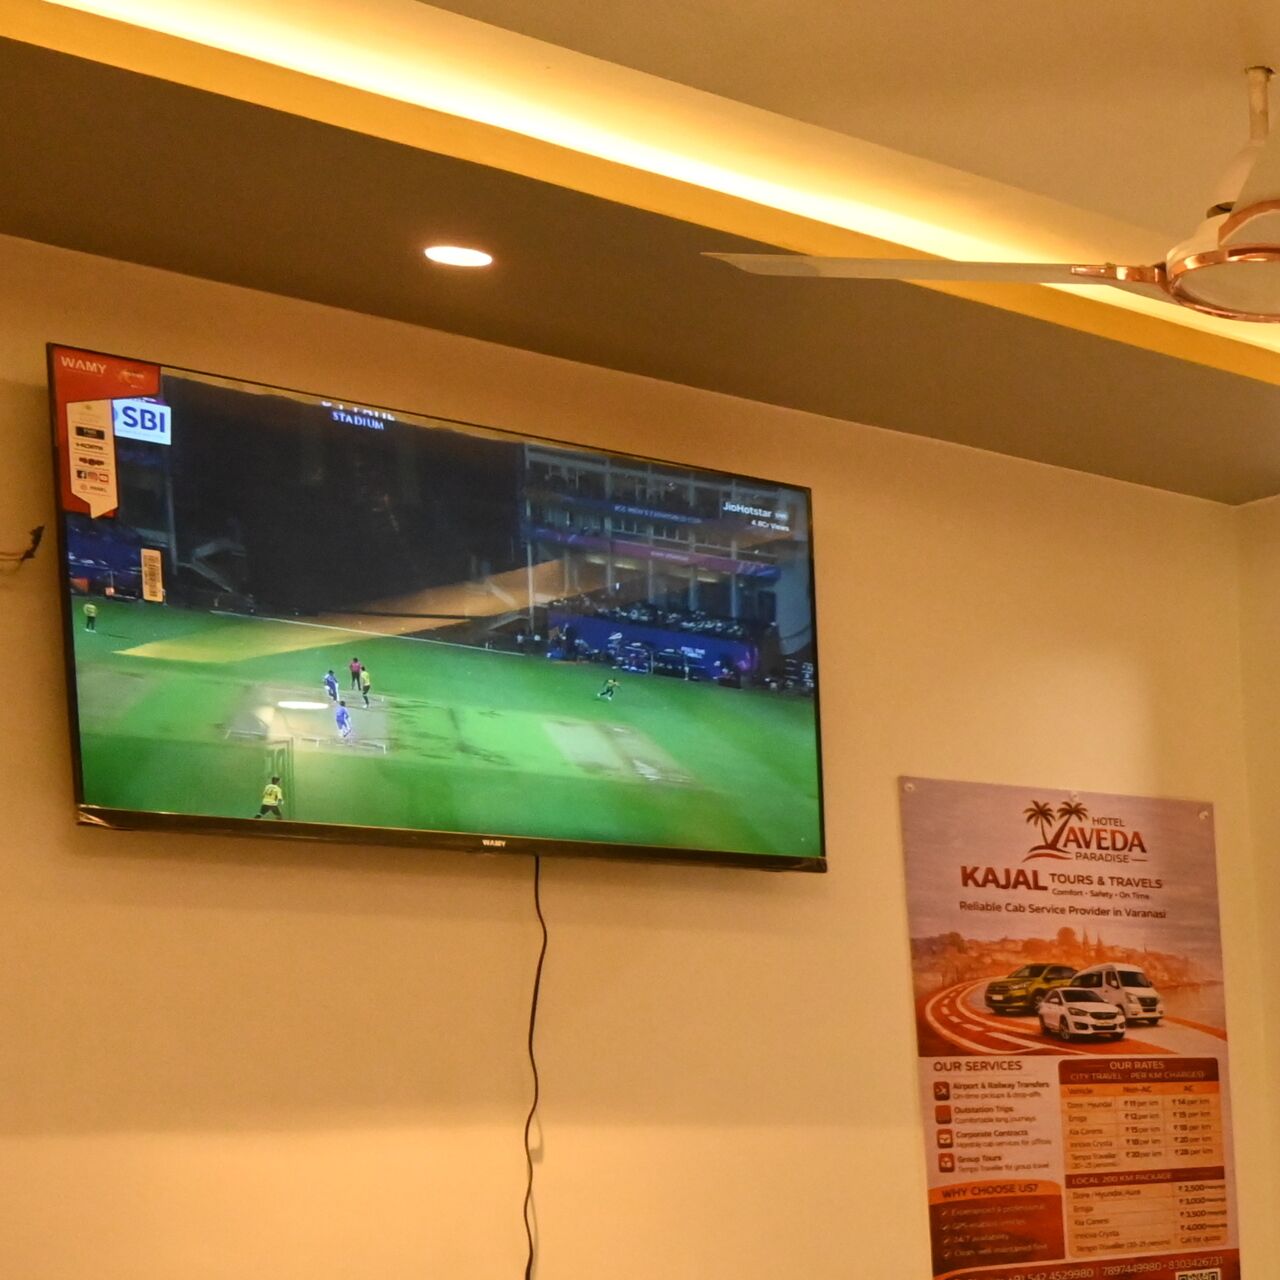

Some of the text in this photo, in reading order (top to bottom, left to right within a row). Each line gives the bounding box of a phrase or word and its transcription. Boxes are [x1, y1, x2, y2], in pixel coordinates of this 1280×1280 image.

[60, 356, 107, 375] WAMY
[122, 405, 166, 433] SBI
[332, 411, 384, 430] STADIUM
[723, 501, 772, 518] JioHotstar
[1092, 816, 1125, 827] HOTEL
[482, 839, 506, 848] WAMY
[1063, 826, 1147, 853] AVEDA
[1075, 852, 1129, 863] PARADISE
[961, 866, 1163, 891] KAJAL TOURS & TRAVELS
[1052, 888, 1083, 897] Comfort
[1090, 890, 1114, 899] Safety
[1132, 892, 1150, 900] Time
[960, 901, 1167, 919] Reliable Cab Service Provider in Varanasi
[933, 1060, 1022, 1072] OUR SERVICES
[1109, 1061, 1165, 1070] OUR RATES
[953, 1082, 979, 1090] Airport
[987, 1082, 1015, 1090] Railway
[1017, 1081, 1050, 1089] Transfers
[954, 1105, 1014, 1114] Outstation Trips
[956, 1129, 1028, 1139] Corporate Contracts
[957, 1155, 980, 1163] Group
[1072, 1176, 1098, 1184] LOCAL
[942, 1183, 1039, 1198] WHY CHOOSE US?
